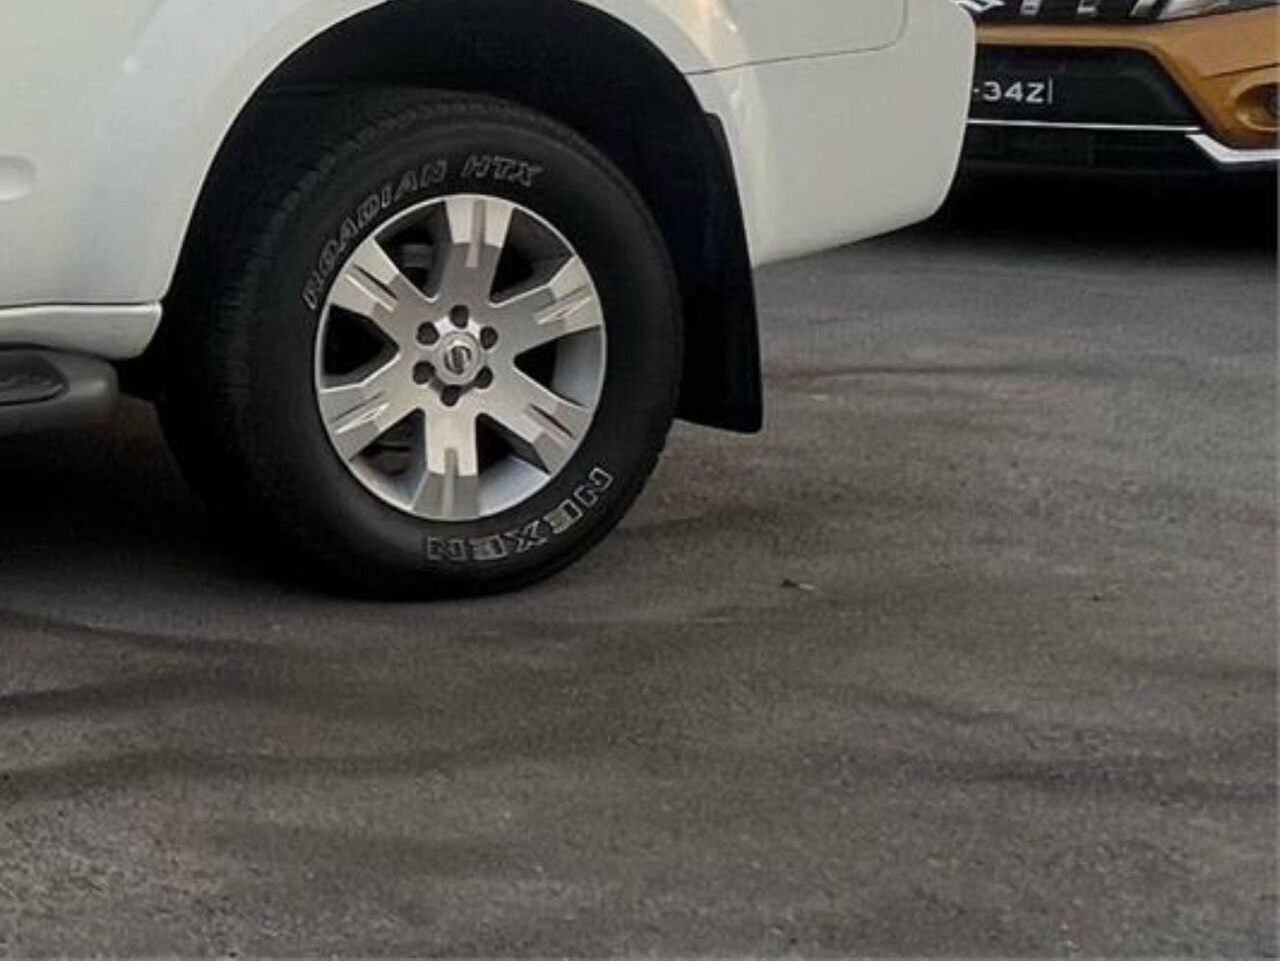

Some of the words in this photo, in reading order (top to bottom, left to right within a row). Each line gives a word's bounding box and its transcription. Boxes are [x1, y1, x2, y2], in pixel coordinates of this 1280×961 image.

[302, 159, 448, 310] ROADIAN
[460, 155, 542, 187] HTX
[426, 467, 614, 561] NEXEN
